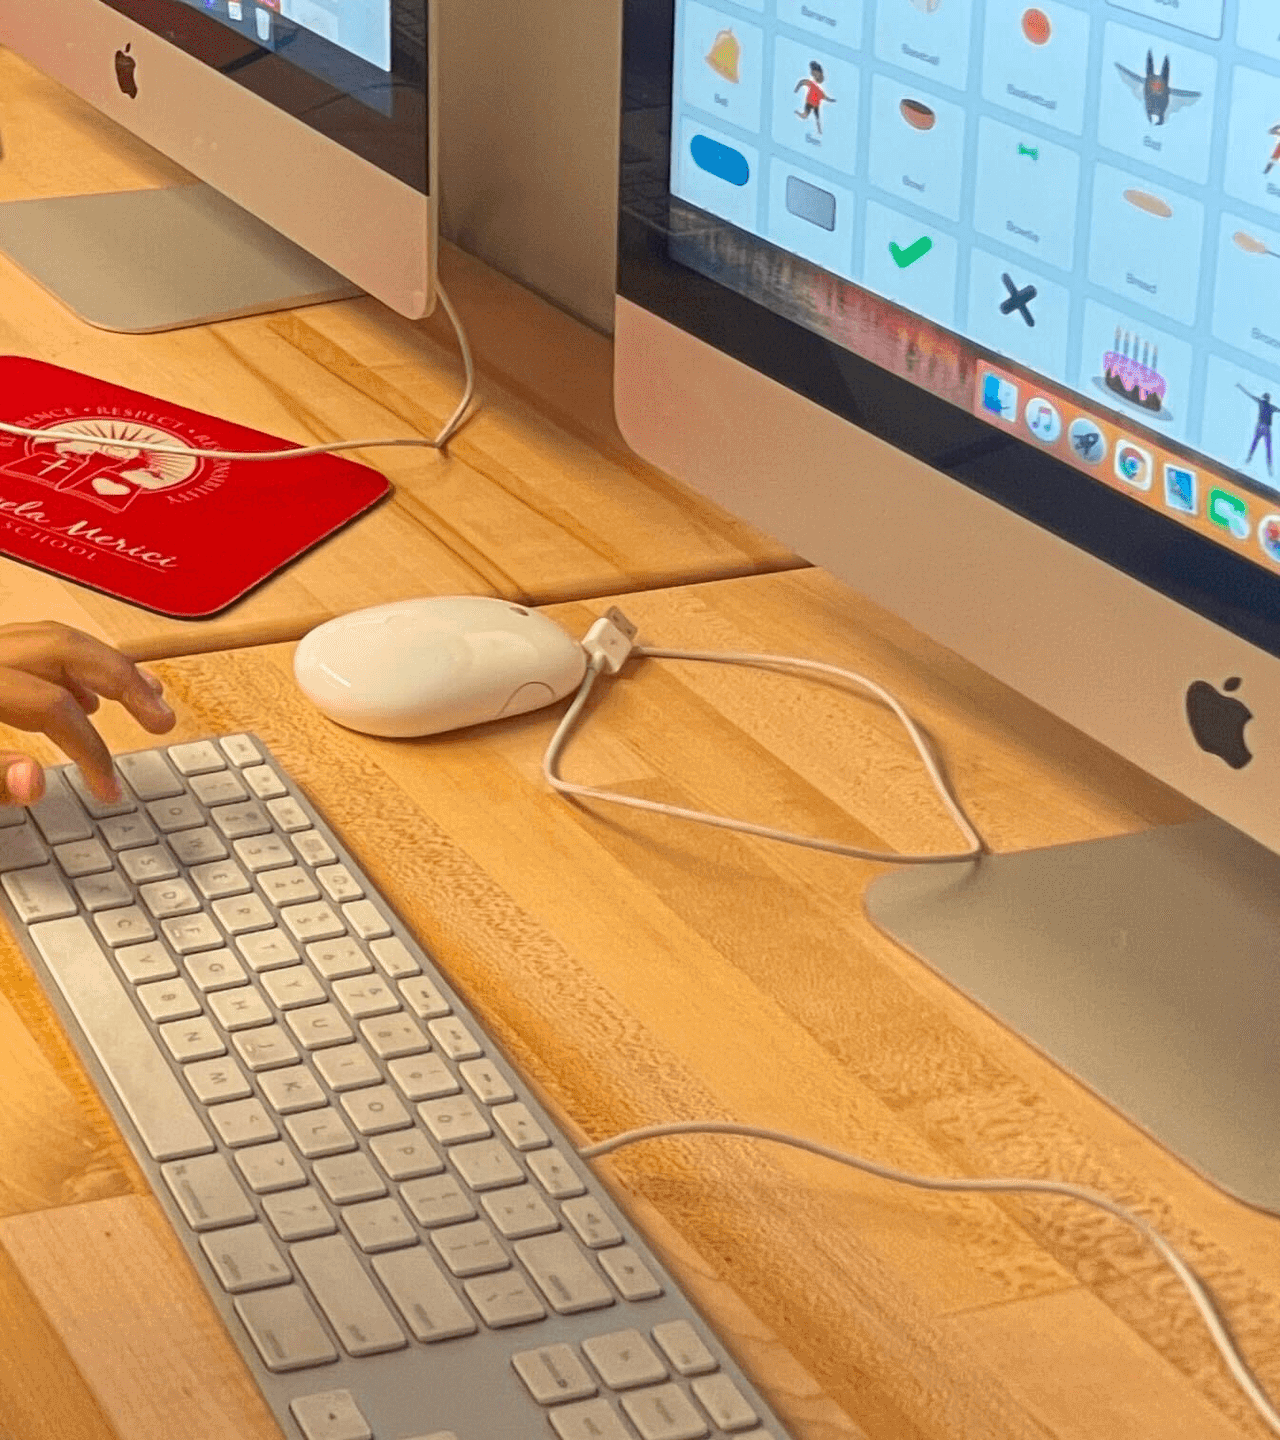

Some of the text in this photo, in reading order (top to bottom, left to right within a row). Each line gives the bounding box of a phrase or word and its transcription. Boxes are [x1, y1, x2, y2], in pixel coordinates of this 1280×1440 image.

[96, 406, 185, 431] RESPECT
[2, 520, 97, 561] SCHOOL
[50, 519, 179, 569] Merici
